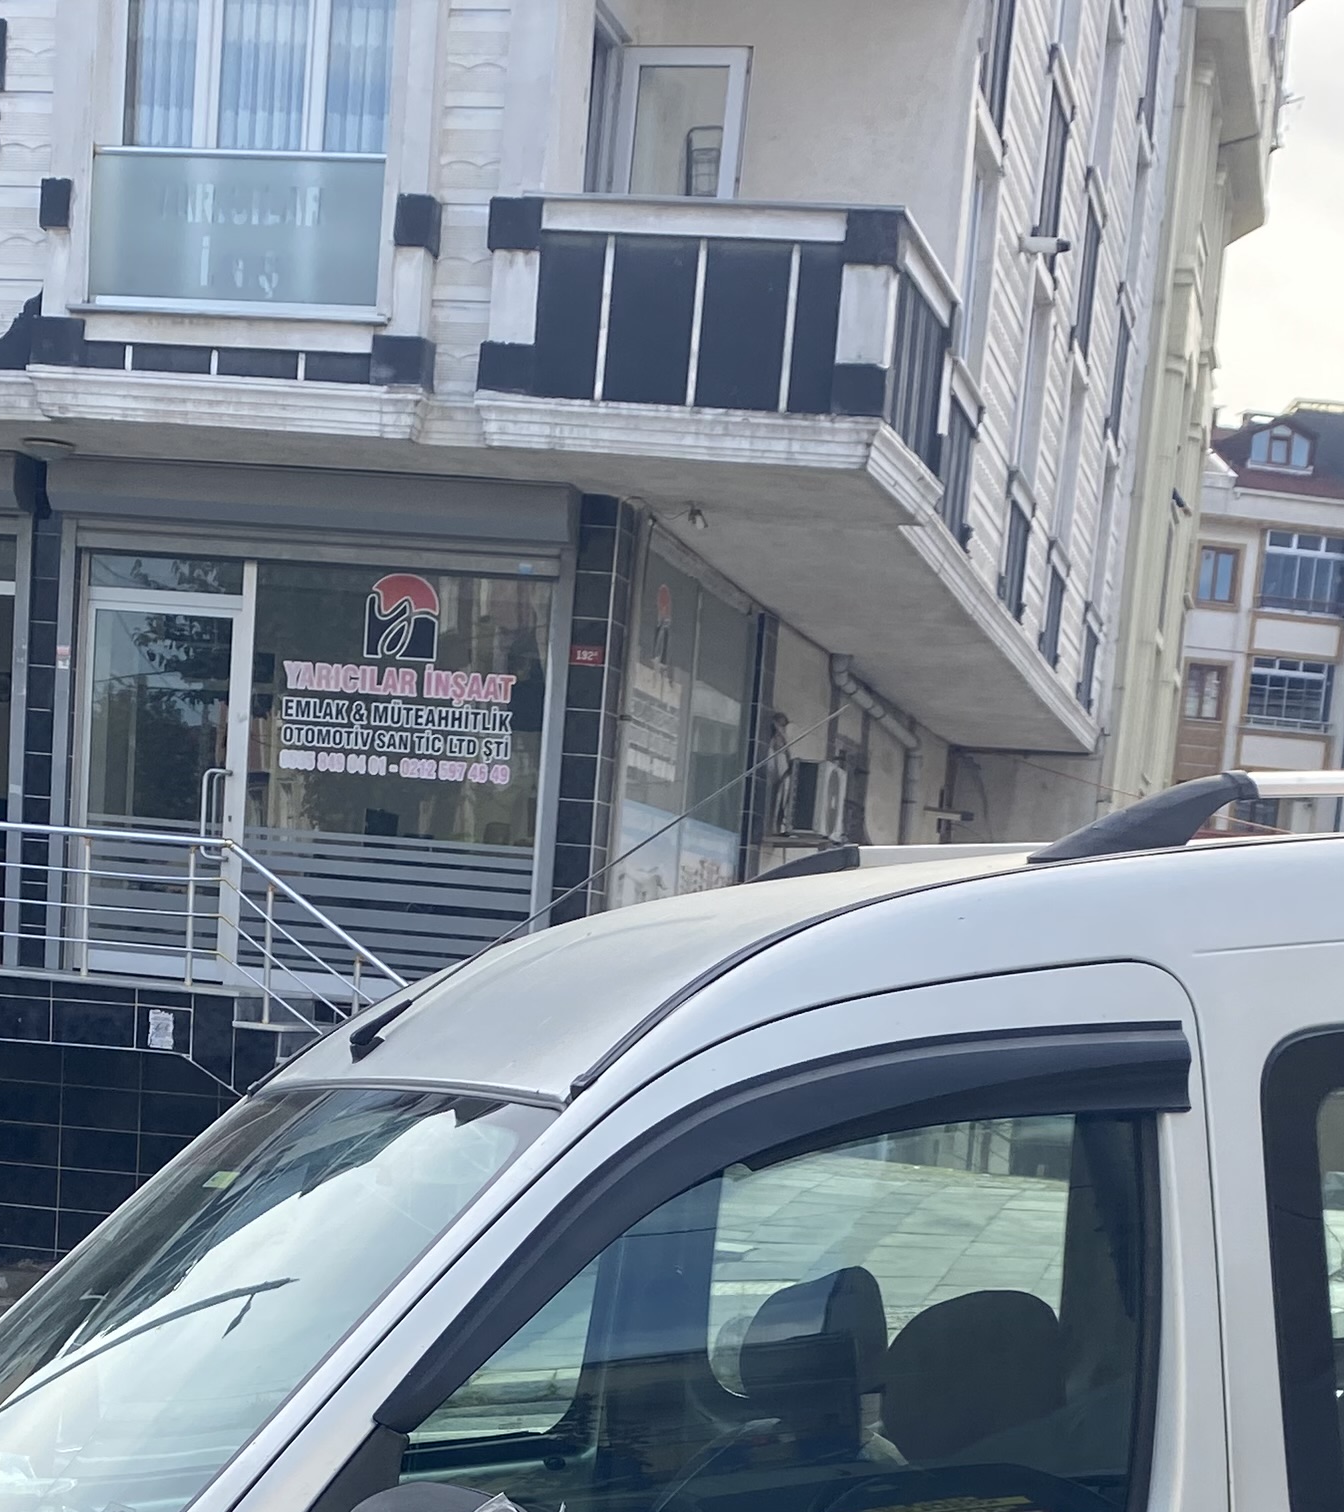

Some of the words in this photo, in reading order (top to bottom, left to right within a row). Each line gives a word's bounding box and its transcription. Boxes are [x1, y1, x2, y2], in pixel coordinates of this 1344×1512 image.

[283, 660, 417, 697] YARICILAR
[423, 663, 516, 707] İNŞAAT
[282, 696, 348, 722] EMLAK
[353, 701, 367, 724] &
[372, 700, 513, 734] MÜTEAHHİTLİK
[281, 723, 373, 748] OTOMOTİV
[375, 731, 409, 753] SAN
[414, 730, 442, 754] TİC
[446, 735, 478, 757] LTD
[483, 736, 511, 763] ŞTİ
[400, 758, 437, 779] 0212
